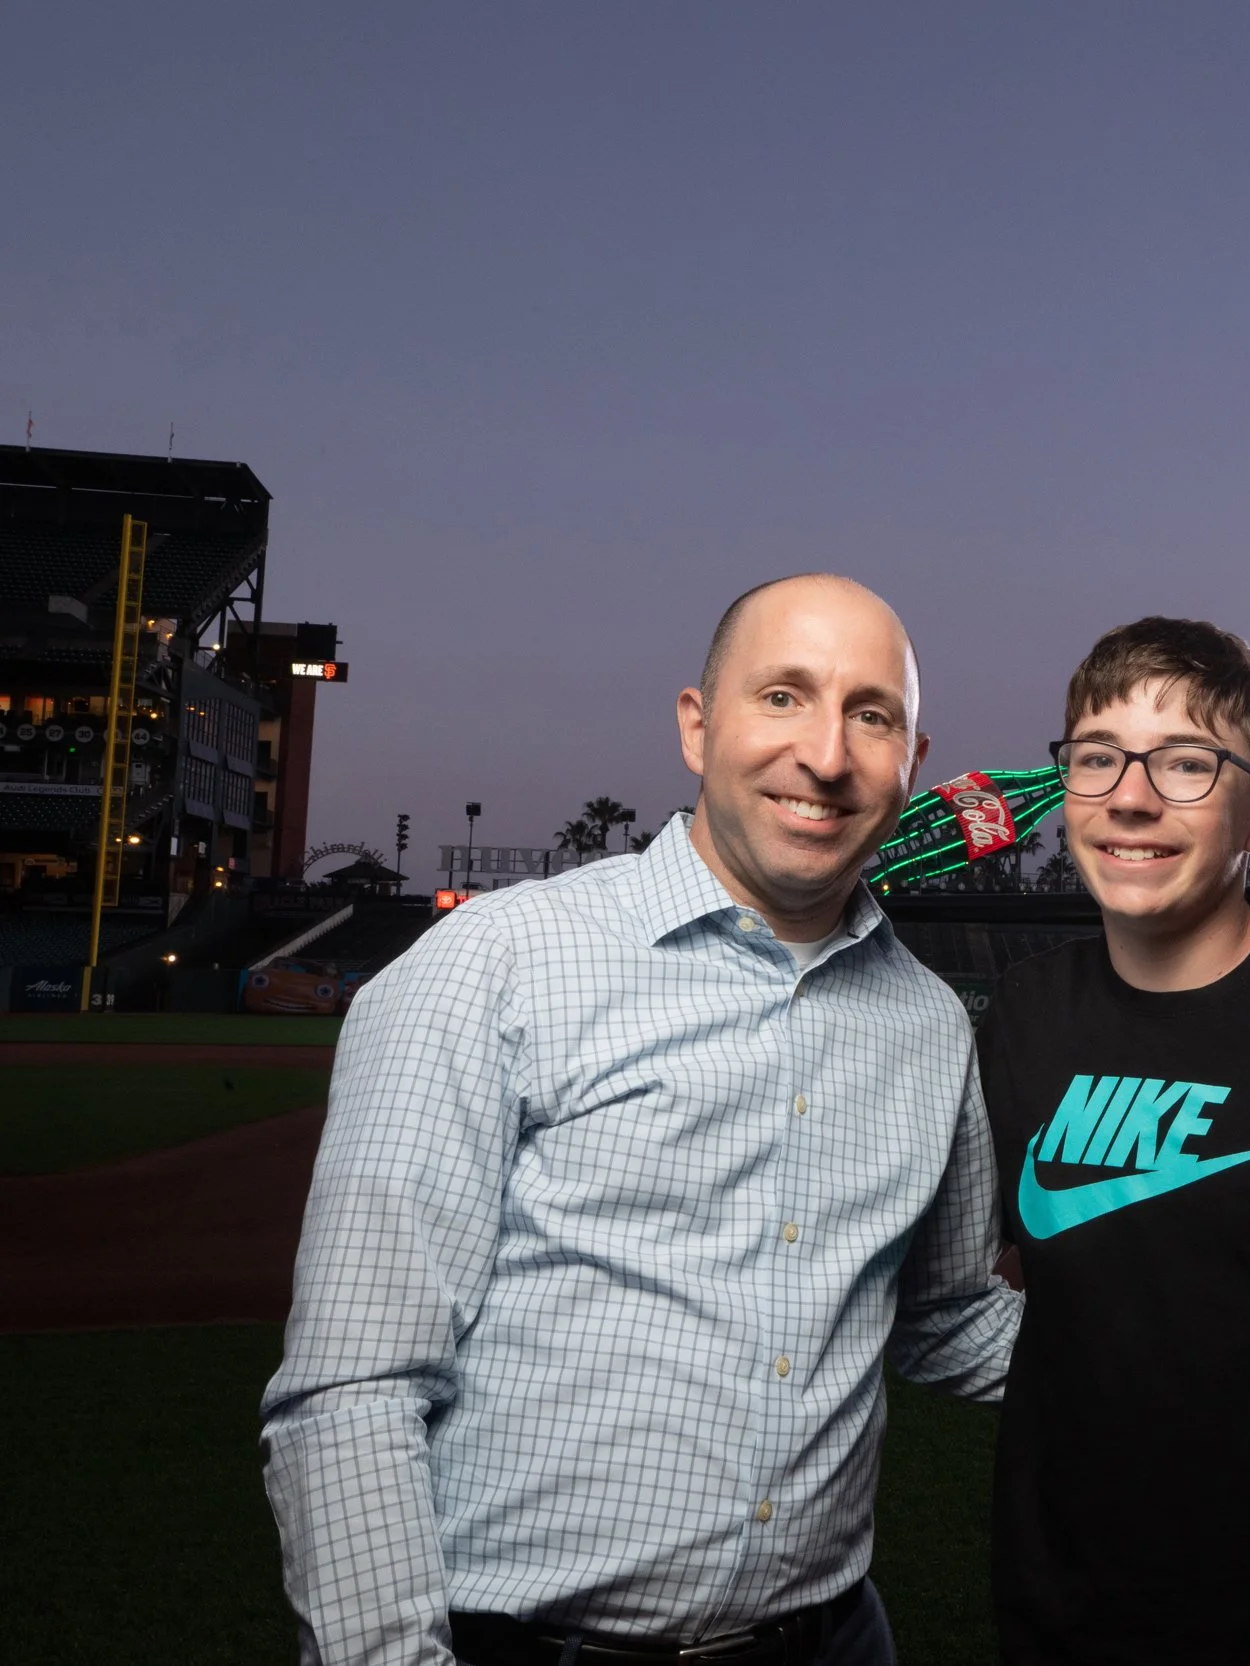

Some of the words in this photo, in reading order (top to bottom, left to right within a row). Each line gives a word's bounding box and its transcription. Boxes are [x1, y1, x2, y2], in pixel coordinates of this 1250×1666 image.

[292, 663, 306, 675] WE
[306, 664, 324, 676] ARE
[25, 980, 72, 992] Alaska
[1037, 1074, 1232, 1172] NIKE
